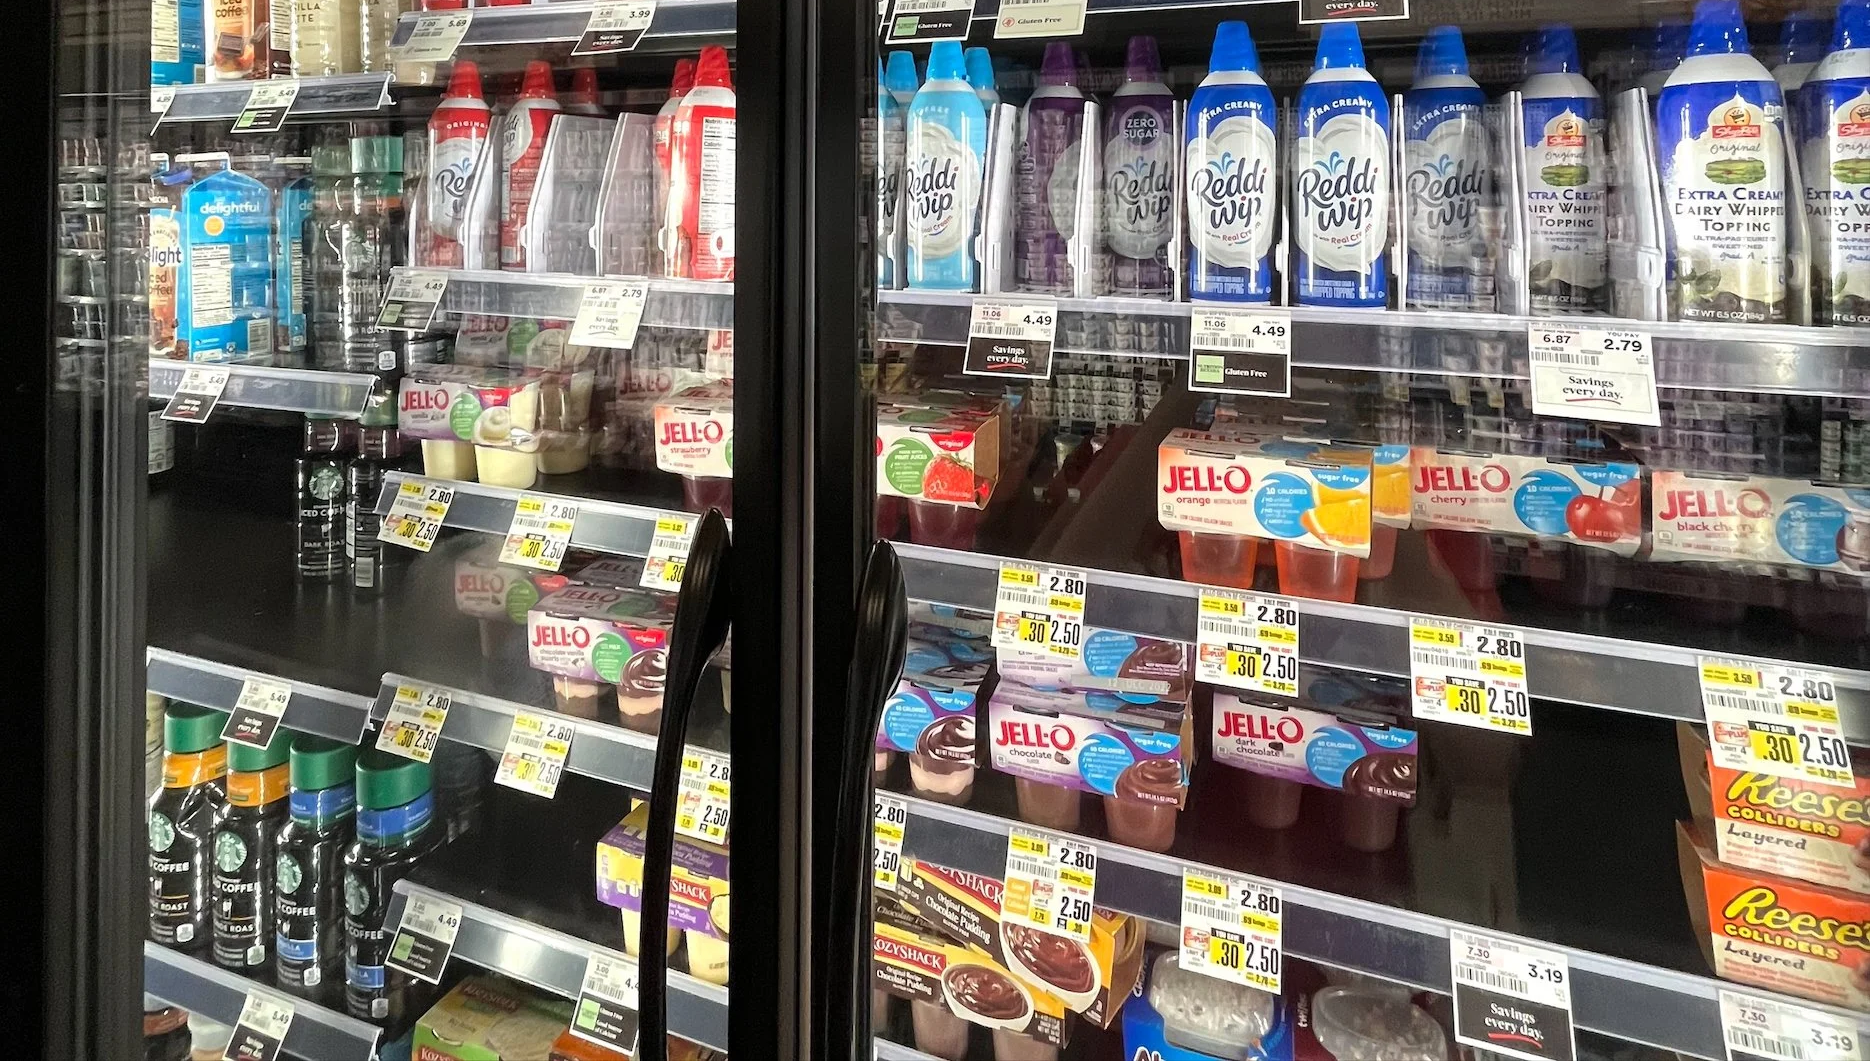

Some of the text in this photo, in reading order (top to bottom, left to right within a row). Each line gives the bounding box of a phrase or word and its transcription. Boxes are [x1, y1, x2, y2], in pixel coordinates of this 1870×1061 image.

[215, 4, 249, 19] coffee
[629, 9, 651, 19] 3.99
[1326, 0, 1355, 11] every
[448, 18, 467, 28] 5.69
[918, 21, 953, 30] Gluten Free
[1017, 15, 1062, 26] Gluten Free
[1225, 100, 1262, 112] CREAMY
[1332, 98, 1373, 111] CREAMY
[1127, 118, 1156, 129] ZERO
[1123, 128, 1160, 139] SUGAR
[906, 156, 959, 200] Reddi
[1191, 156, 1268, 214] Reddi
[1298, 156, 1379, 218] Reddi
[1407, 159, 1486, 216] Reddi
[1678, 188, 1727, 201] EXTRA
[1806, 188, 1854, 201] EXTRA
[200, 200, 262, 218] delightful
[1675, 203, 1722, 216] DAIRY
[1538, 215, 1594, 228] TOPPING
[1699, 218, 1771, 232] TOPPING
[424, 281, 443, 291] 4.49
[622, 289, 642, 299] 2.79
[982, 310, 1052, 326] 11.06 4.49
[1684, 308, 1701, 316] NET
[1203, 320, 1286, 337] 11.06 4.49
[992, 344, 1025, 356] Savings
[1543, 334, 1643, 353] 6.87 2.79
[986, 354, 1029, 365] every day.
[1224, 367, 1268, 379] Gluten Free
[1568, 375, 1614, 390] Savings
[401, 388, 449, 413] JELL-O
[1562, 386, 1624, 400] every day.
[659, 419, 724, 447] JELL-O
[670, 446, 711, 458] strawberry
[1163, 464, 1252, 495] JELL-O
[1317, 473, 1360, 484] sugar free
[1414, 464, 1512, 494] JELL-O
[429, 489, 451, 504] 2.80
[1176, 497, 1211, 507] orange
[1430, 494, 1467, 506] cherry
[1658, 488, 1772, 519] JELL-O
[551, 505, 575, 520] 2.80
[416, 521, 436, 541] 2.50
[1677, 520, 1710, 533] black
[522, 540, 563, 560] .30 2.50
[1049, 576, 1084, 596] 2.80
[1257, 605, 1297, 627] 2.80
[532, 624, 591, 649] JELL-O
[1024, 620, 1081, 646] .30 2.50
[1476, 635, 1522, 659] 2.80
[1232, 652, 1297, 682] .30 2.50
[1779, 675, 1834, 702] 2.80
[269, 693, 287, 703] 5.49
[426, 693, 449, 711] 2.80
[1455, 687, 1528, 718] .30 2.50
[546, 726, 573, 742] 2.80
[1217, 710, 1305, 743] JELL-O
[397, 729, 437, 751] .30 2.50
[995, 721, 1077, 752] JELL-O
[1236, 738, 1256, 747] dark
[1009, 747, 1053, 760] chocolate
[1236, 745, 1280, 758] chocolate
[1762, 733, 1849, 769] .30 2.50
[536, 763, 560, 786] 2.50
[703, 804, 730, 827] 2.50
[874, 803, 905, 825] 2.80
[1727, 805, 1840, 838] COLLIDERS
[1727, 822, 1808, 852] Layered
[874, 849, 899, 872] 2.50
[1059, 847, 1095, 870] 2.80
[154, 862, 190, 874] COFFEE
[161, 902, 189, 913] ROAST
[281, 905, 316, 916] COFFEE
[936, 892, 980, 923] Original Recipe
[1060, 895, 1092, 923] 2.50
[1240, 889, 1280, 914] 2.80
[437, 915, 457, 929] 4.49
[925, 895, 991, 945] Chocolate Pudding
[350, 929, 384, 940] COFFEE
[1723, 924, 1840, 962] COLLIDERS
[1216, 941, 1279, 975] .30 2.50
[1466, 946, 1564, 984] 7.30 3.19
[1724, 940, 1806, 972] Layered
[886, 965, 923, 981] Original Recipe
[876, 969, 932, 996] Chocolate Pudding
[272, 1011, 290, 1025] 5.49
[1490, 1001, 1536, 1023] Savings
[1484, 1016, 1545, 1041] every day.
[1740, 1008, 1853, 1053] 7.30 3.19
